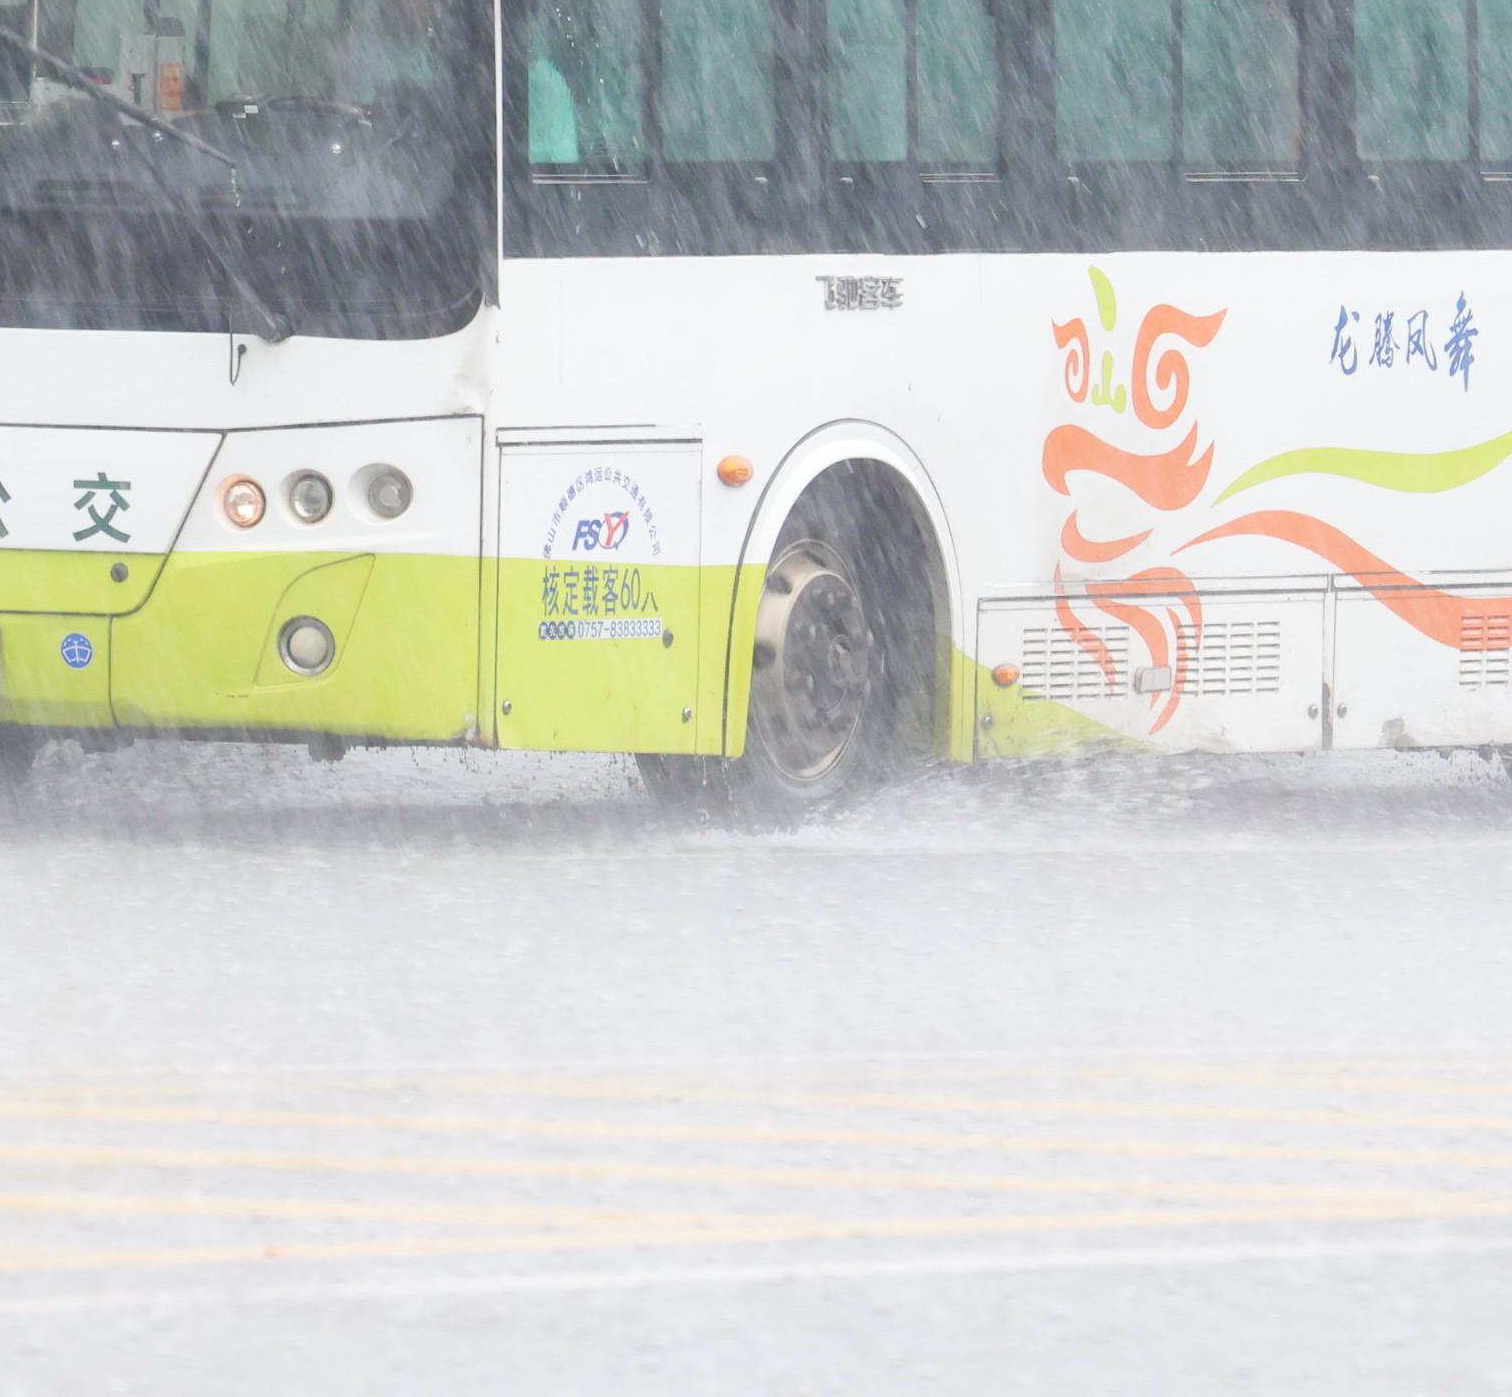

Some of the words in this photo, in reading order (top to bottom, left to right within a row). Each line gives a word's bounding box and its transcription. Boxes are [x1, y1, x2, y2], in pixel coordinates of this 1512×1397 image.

[541, 565, 659, 618] 核定载客60人
